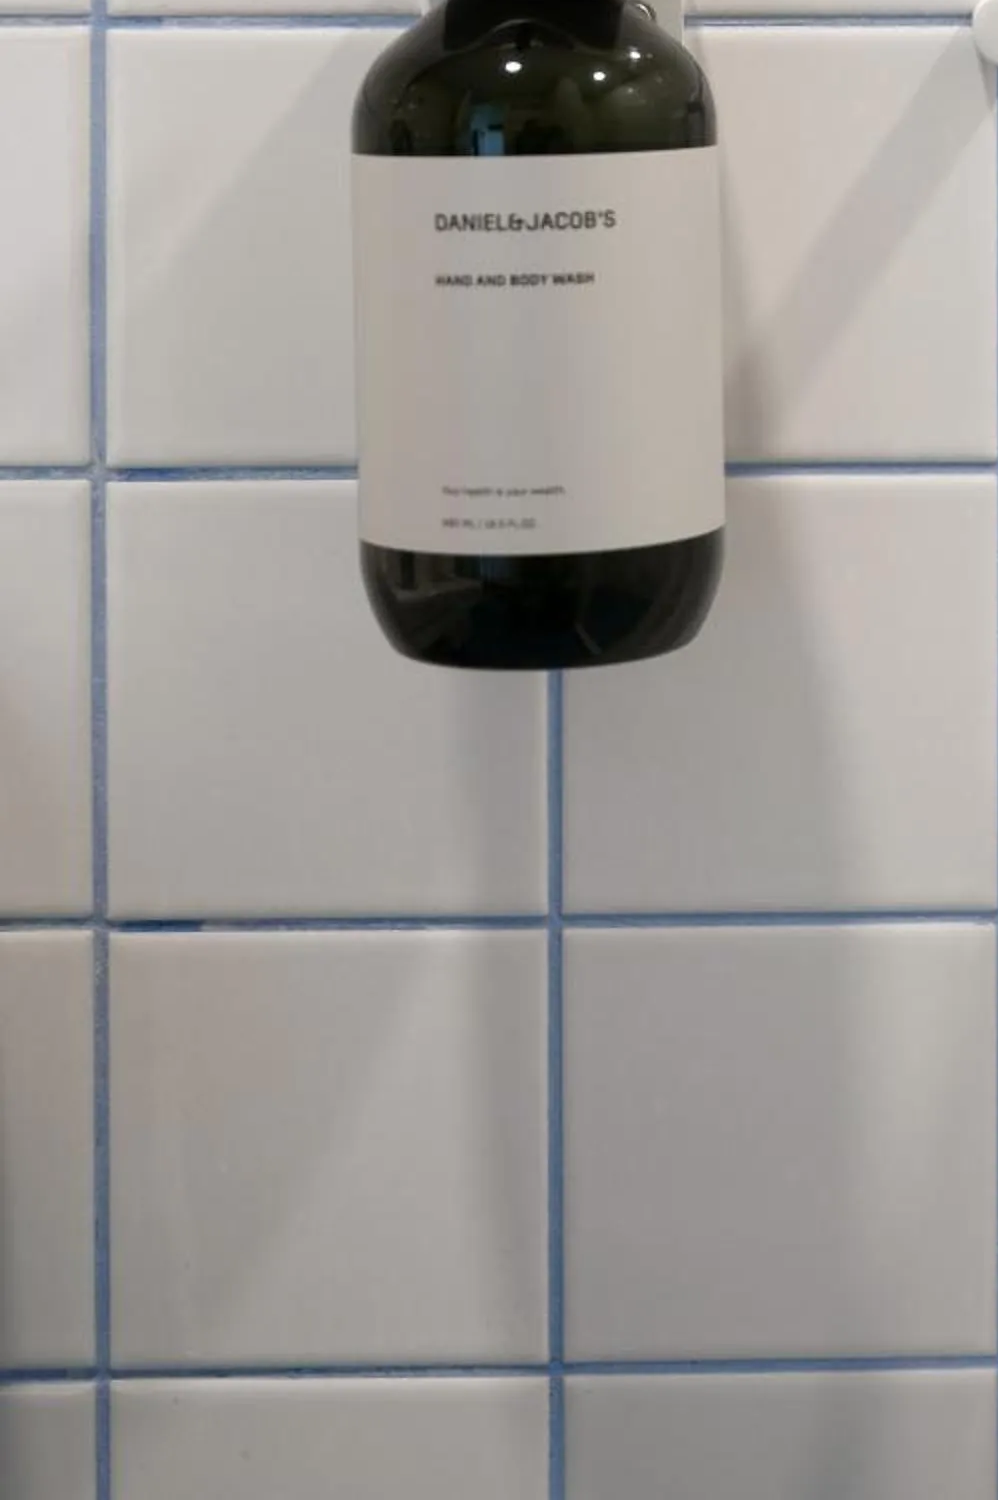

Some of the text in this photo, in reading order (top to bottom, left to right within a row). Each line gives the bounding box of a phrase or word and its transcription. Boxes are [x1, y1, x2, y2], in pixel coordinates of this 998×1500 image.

[434, 209, 616, 232] DANIEL&JACOB'S
[435, 272, 595, 287] HAND AND BODY WASH
